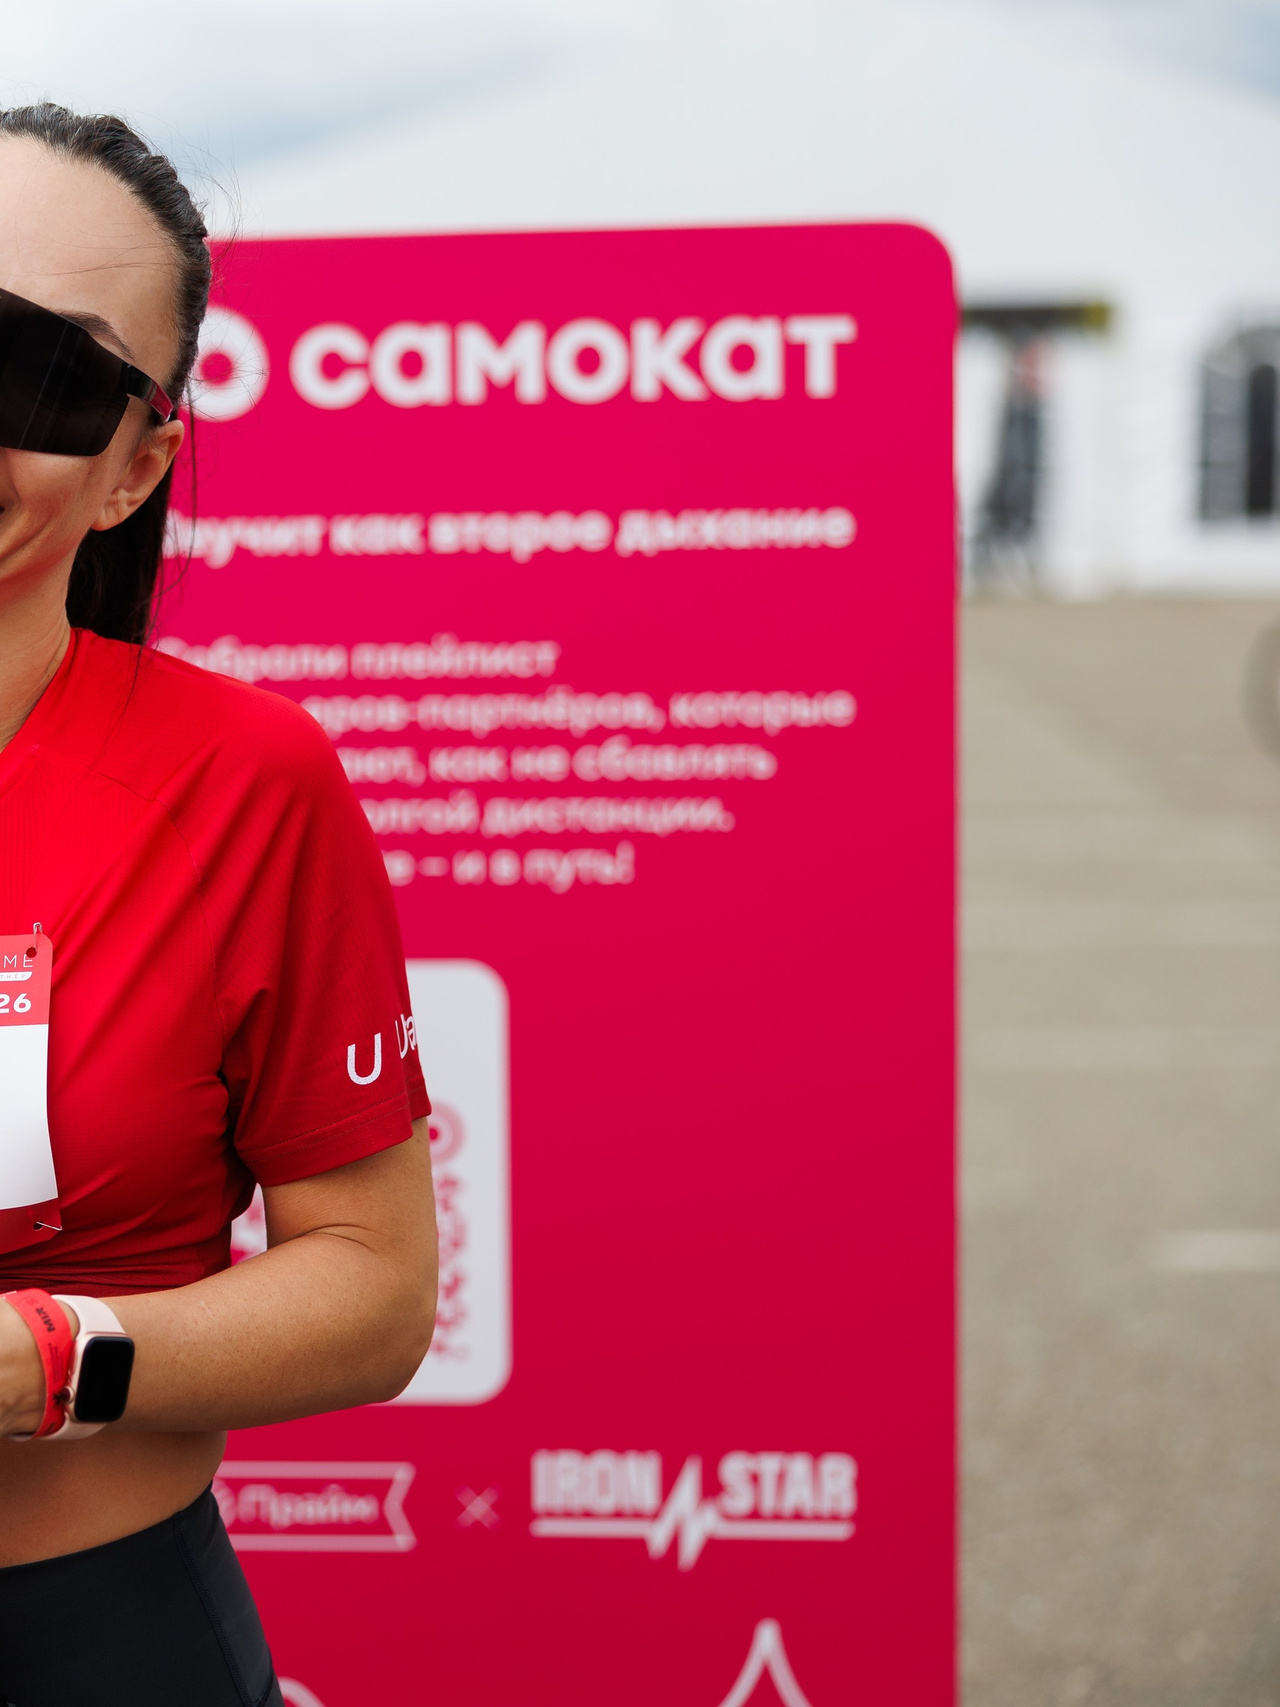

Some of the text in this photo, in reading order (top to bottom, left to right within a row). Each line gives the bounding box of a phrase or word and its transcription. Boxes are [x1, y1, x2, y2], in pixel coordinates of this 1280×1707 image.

[288, 312, 857, 410] самокат
[329, 513, 426, 556] как
[428, 509, 610, 564] второе
[613, 506, 857, 557] дыхание
[350, 632, 561, 680] плейлист
[669, 690, 857, 736] которые
[428, 745, 509, 782] как
[510, 744, 570, 782] не
[523, 839, 635, 895] путь!
[530, 1448, 858, 1518] IRON STAR
